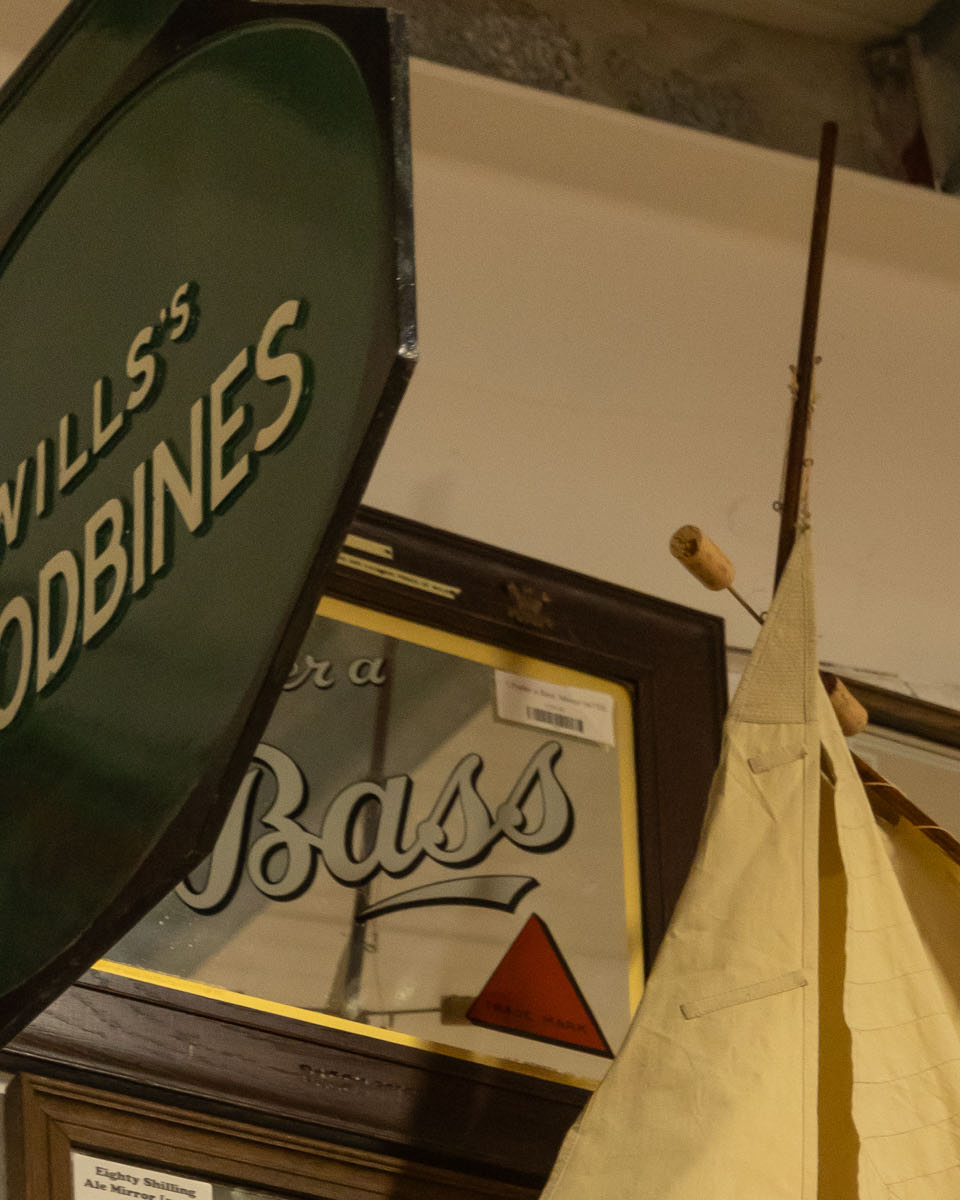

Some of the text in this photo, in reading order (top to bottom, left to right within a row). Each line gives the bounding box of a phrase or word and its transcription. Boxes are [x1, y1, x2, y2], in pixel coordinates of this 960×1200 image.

[349, 658, 386, 686] a
[174, 740, 574, 916] Bass
[84, 1178, 107, 1191] Ale
[96, 1166, 197, 1199] Eighty Shilling
